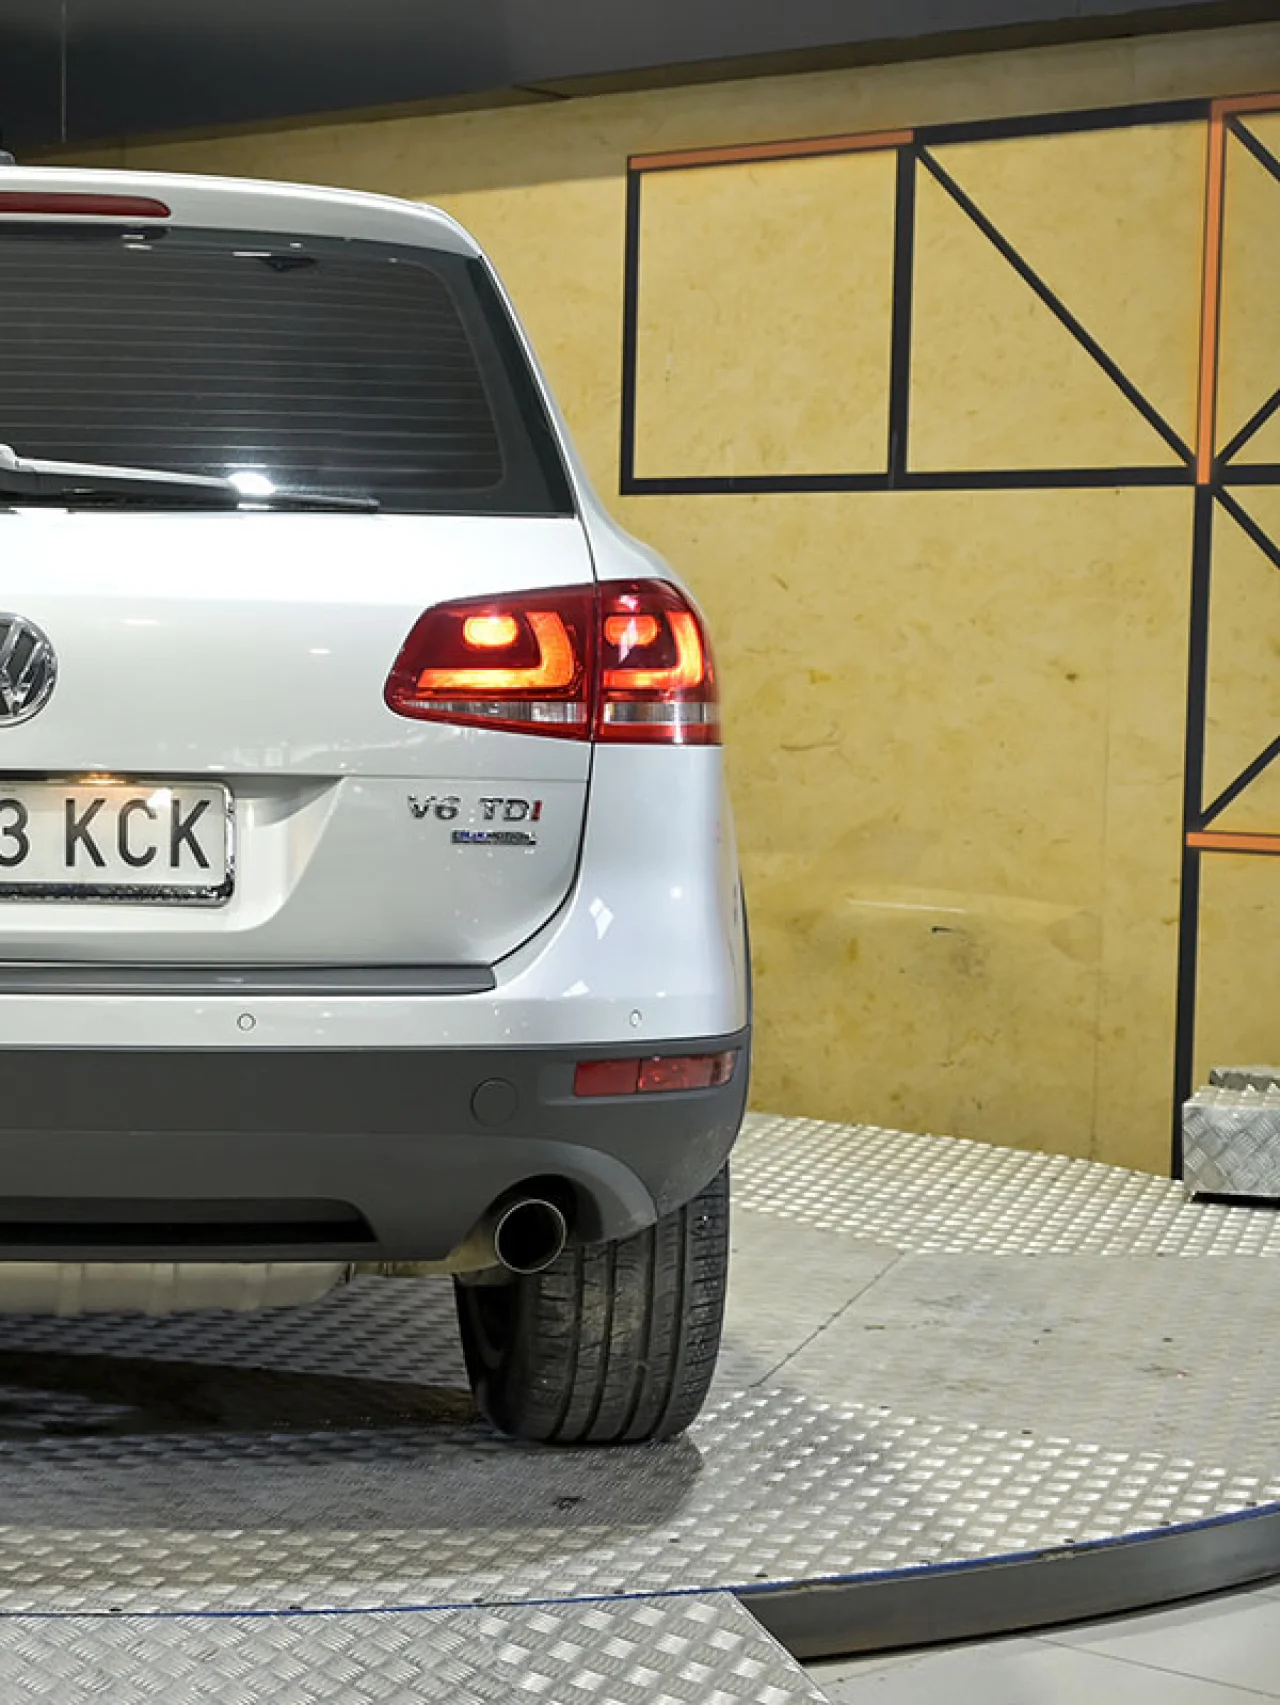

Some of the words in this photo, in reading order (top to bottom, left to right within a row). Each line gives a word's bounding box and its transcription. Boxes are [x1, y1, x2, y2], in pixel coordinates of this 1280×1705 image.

[408, 795, 461, 820] V6
[480, 797, 542, 821] TDI
[64, 797, 211, 869] KCK
